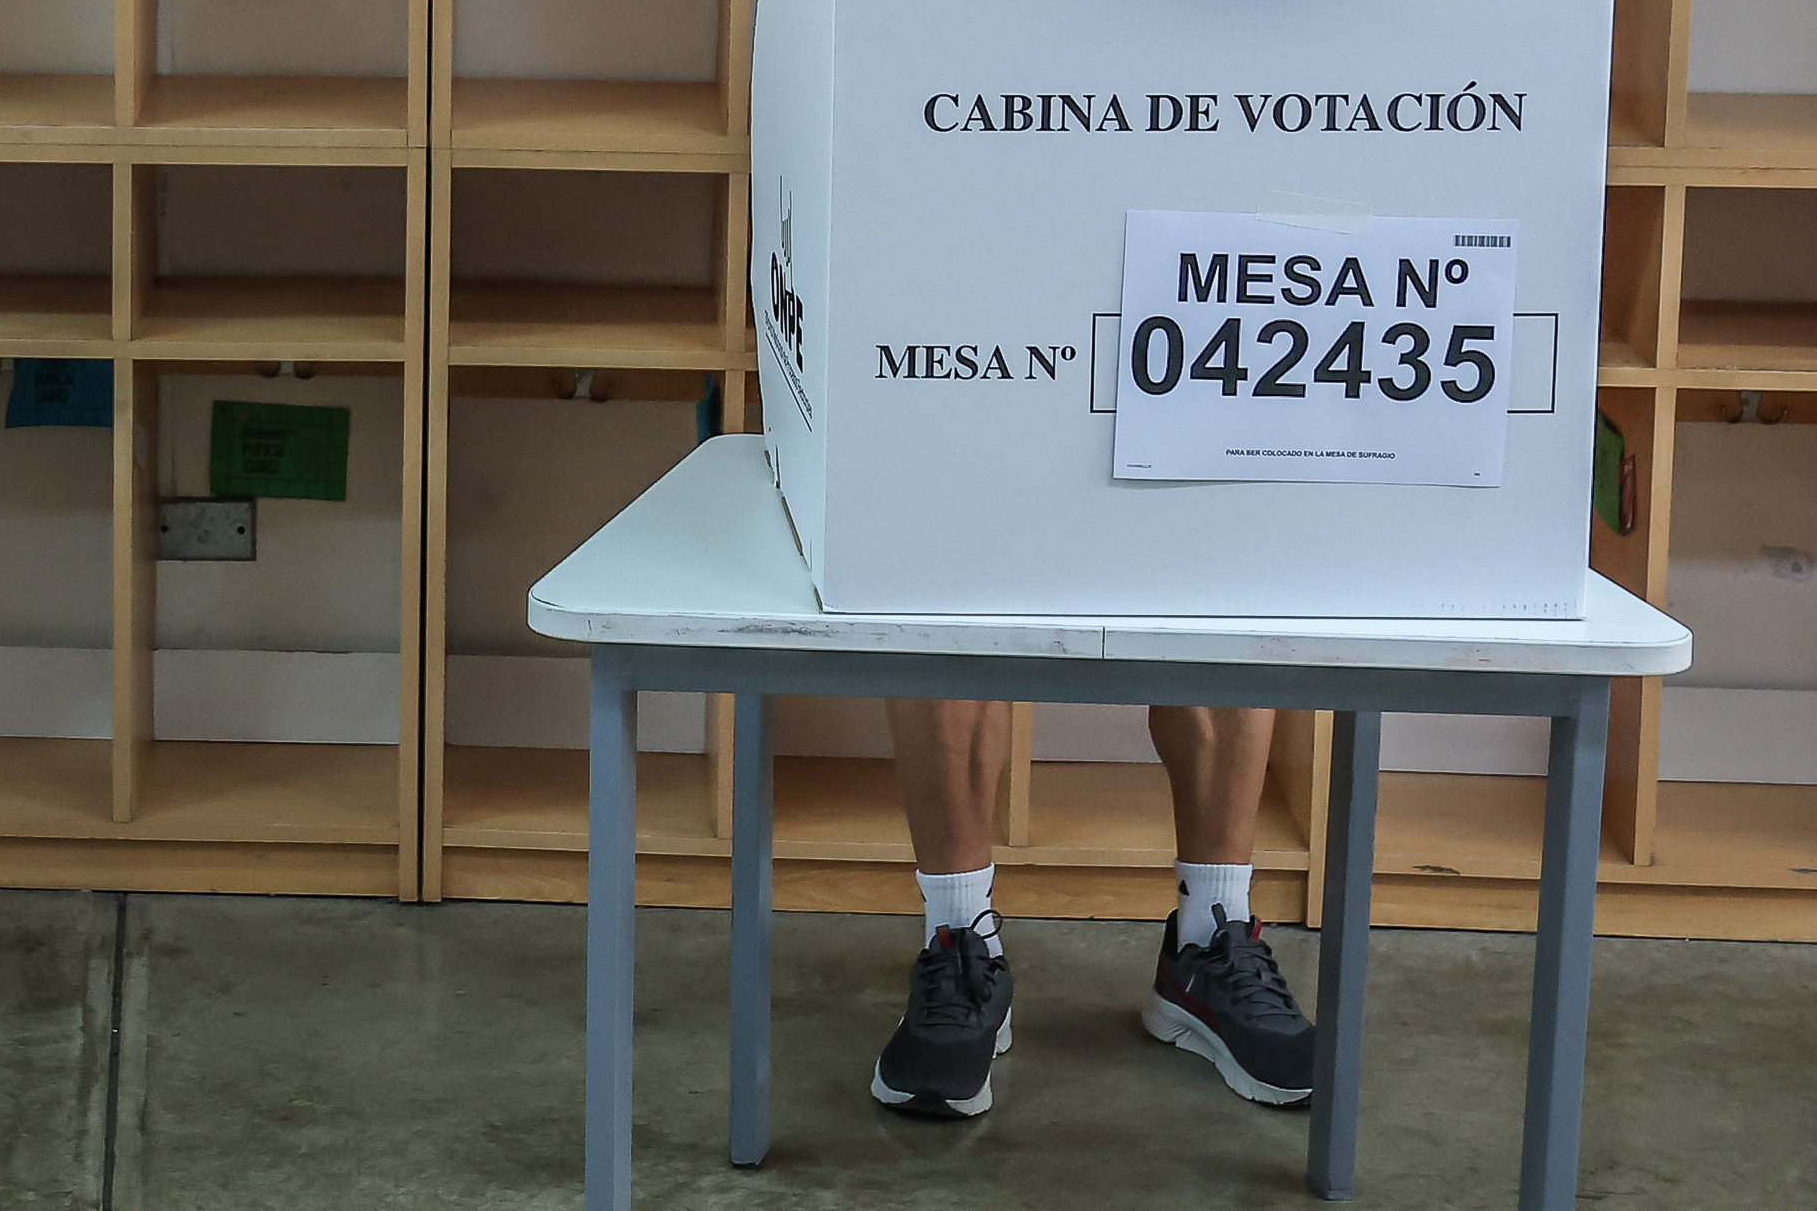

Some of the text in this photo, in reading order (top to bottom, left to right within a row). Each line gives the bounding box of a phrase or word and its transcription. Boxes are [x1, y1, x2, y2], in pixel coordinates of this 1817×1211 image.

[924, 80, 1528, 133] CABINA DE VOTACIÓN
[1177, 252, 1375, 308] MESA
[874, 344, 1015, 380] MESA
[1131, 315, 1496, 404] 042435
[1358, 452, 1396, 460] SUFRAGIO
